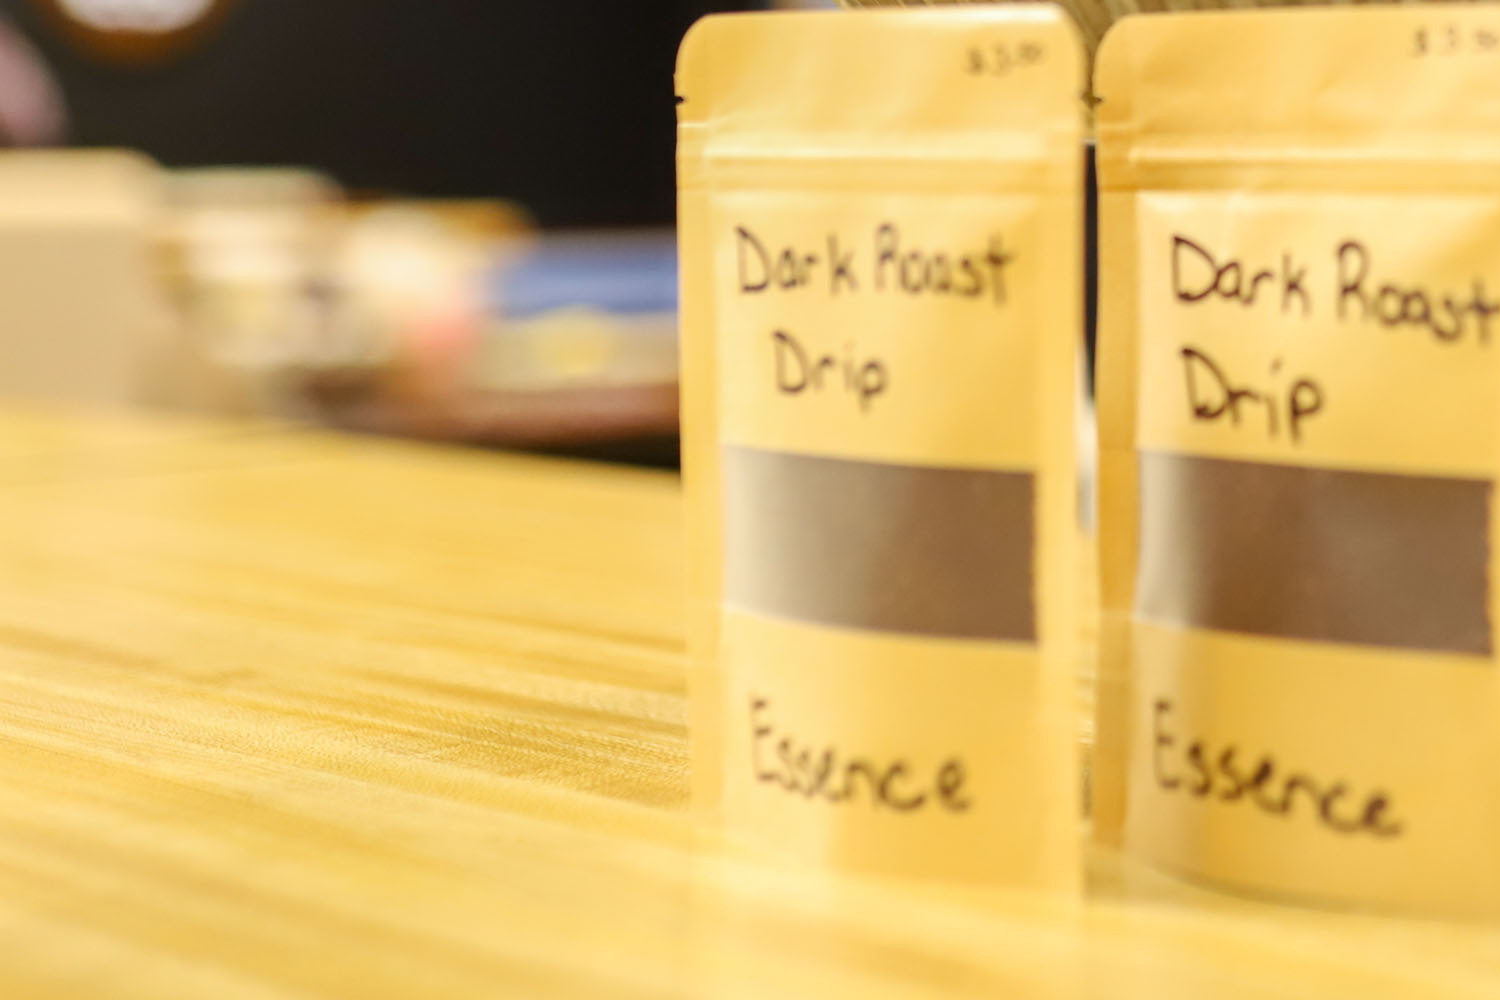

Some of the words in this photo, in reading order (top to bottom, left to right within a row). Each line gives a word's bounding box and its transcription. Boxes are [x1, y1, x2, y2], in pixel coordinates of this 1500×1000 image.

[735, 223, 858, 295] Dark
[875, 222, 1017, 307] Roast
[1172, 233, 1311, 317] Dark
[773, 329, 890, 412] Drip
[1181, 346, 1325, 444] Drip
[749, 696, 971, 812] Essence
[1153, 700, 1405, 837] Essence
